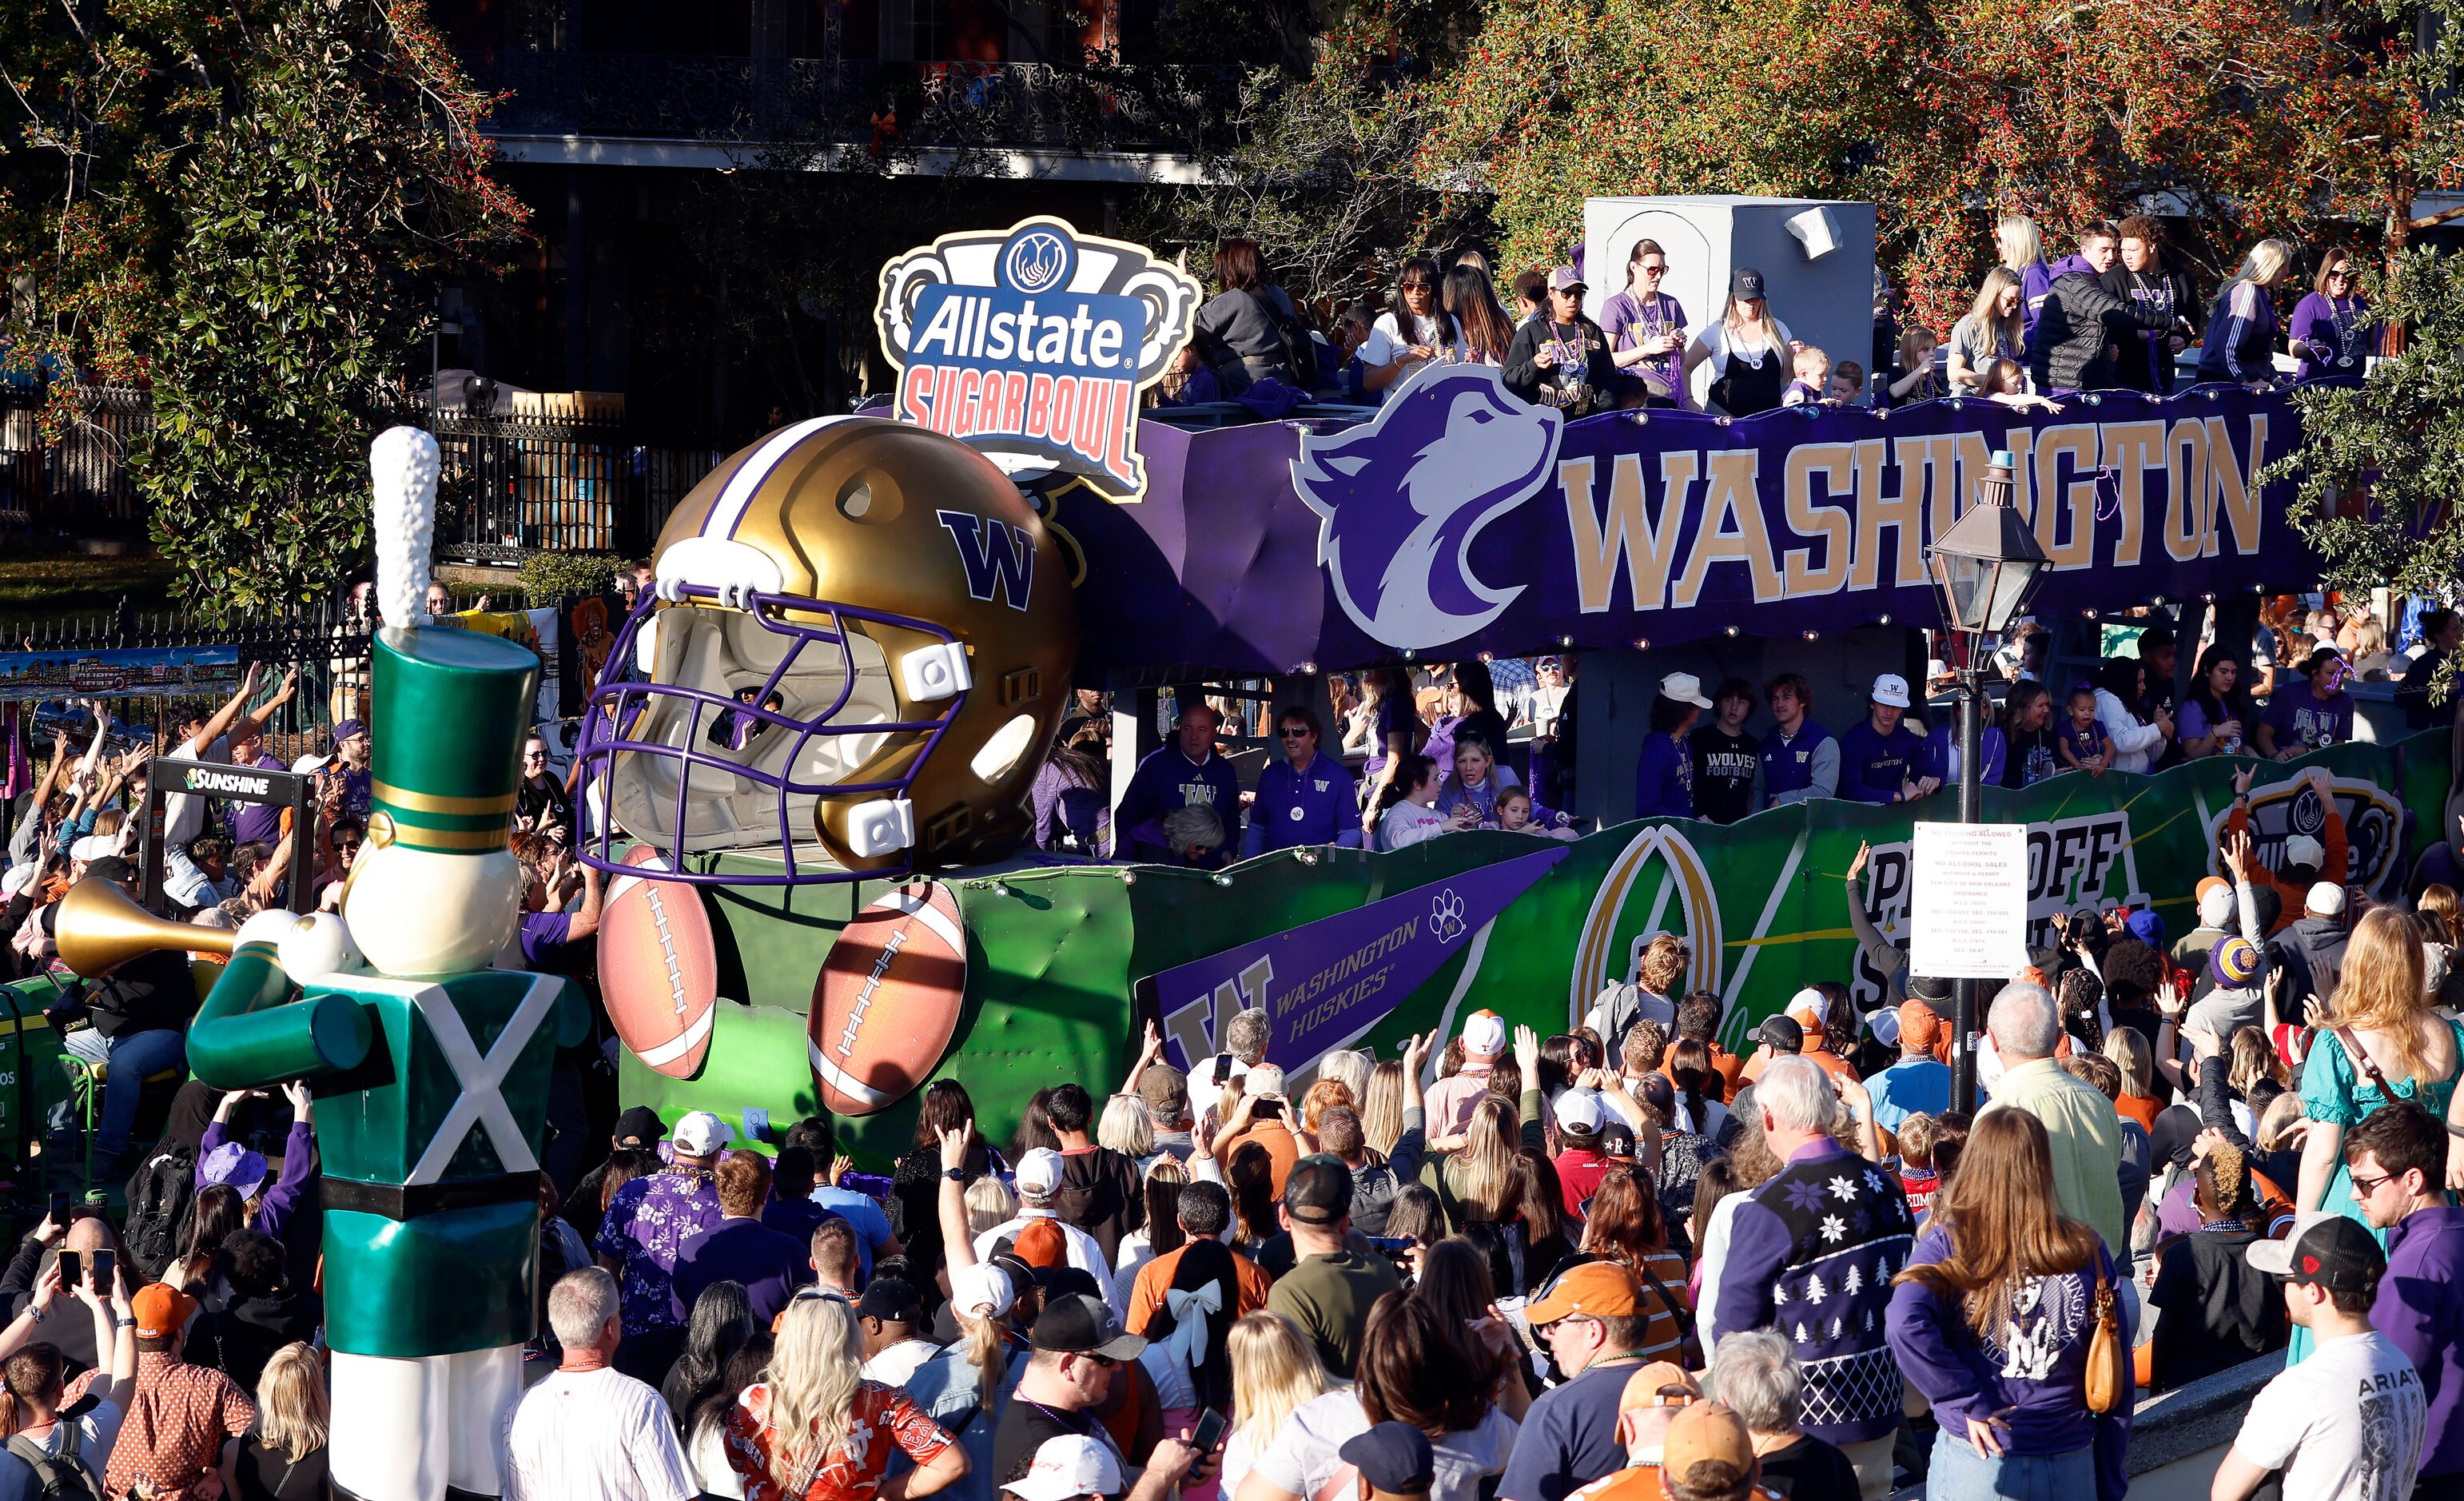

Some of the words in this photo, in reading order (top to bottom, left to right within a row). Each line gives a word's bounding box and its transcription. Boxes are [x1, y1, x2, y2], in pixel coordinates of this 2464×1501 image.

[1743, 277, 1757, 288] W
[912, 294, 1124, 368] Allstate
[902, 364, 1029, 437] SUGAR
[1025, 372, 1140, 488] BOWL
[936, 509, 1039, 612] W
[1707, 753, 1755, 769] WOLVES
[1796, 750, 1809, 763] W
[194, 768, 270, 795] SUNSHINE
[1314, 779, 1330, 792] W
[1869, 821, 2123, 923] POFF
[1443, 919, 1456, 936] W
[1276, 915, 1420, 1019] WASHINGTON
[1288, 969, 1388, 1044] HUSKIES
[683, 1128, 692, 1137] W
[750, 1112, 761, 1137] 8
[1614, 1137, 1623, 1154] R
[1906, 1192, 1934, 1208] EDM
[2359, 1368, 2418, 1397] ARIAT
